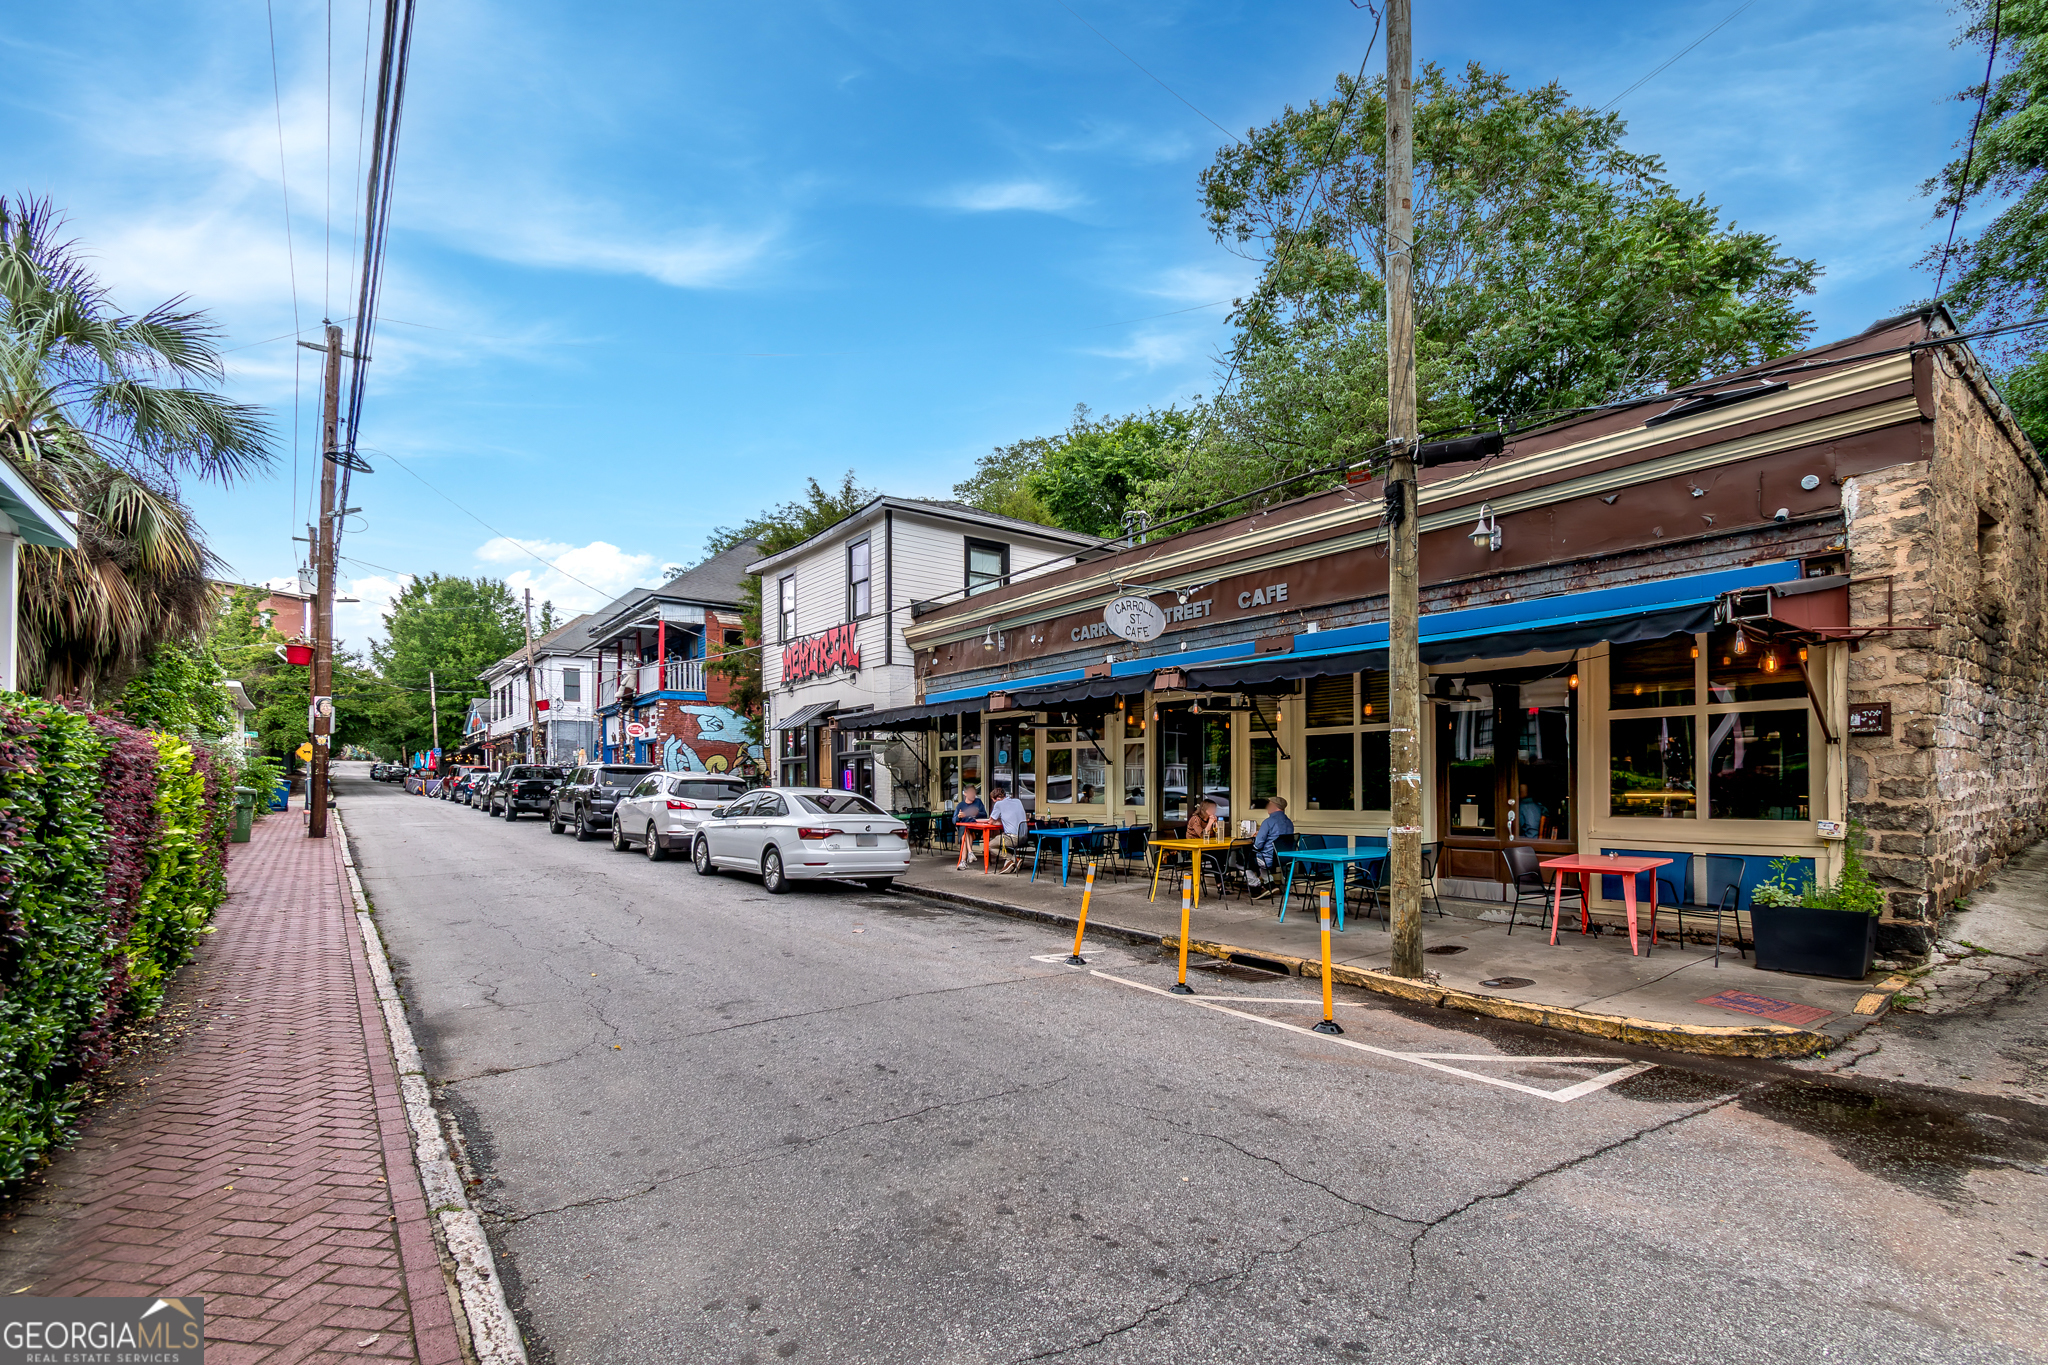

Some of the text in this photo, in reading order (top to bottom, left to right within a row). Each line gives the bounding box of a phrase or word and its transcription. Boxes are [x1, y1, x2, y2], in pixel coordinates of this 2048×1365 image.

[1071, 583, 1288, 642] CARR TREET CAFE
[1114, 600, 1154, 618] CARROLL
[1129, 613, 1142, 625] ST.
[780, 622, 862, 686] MEMORIAL
